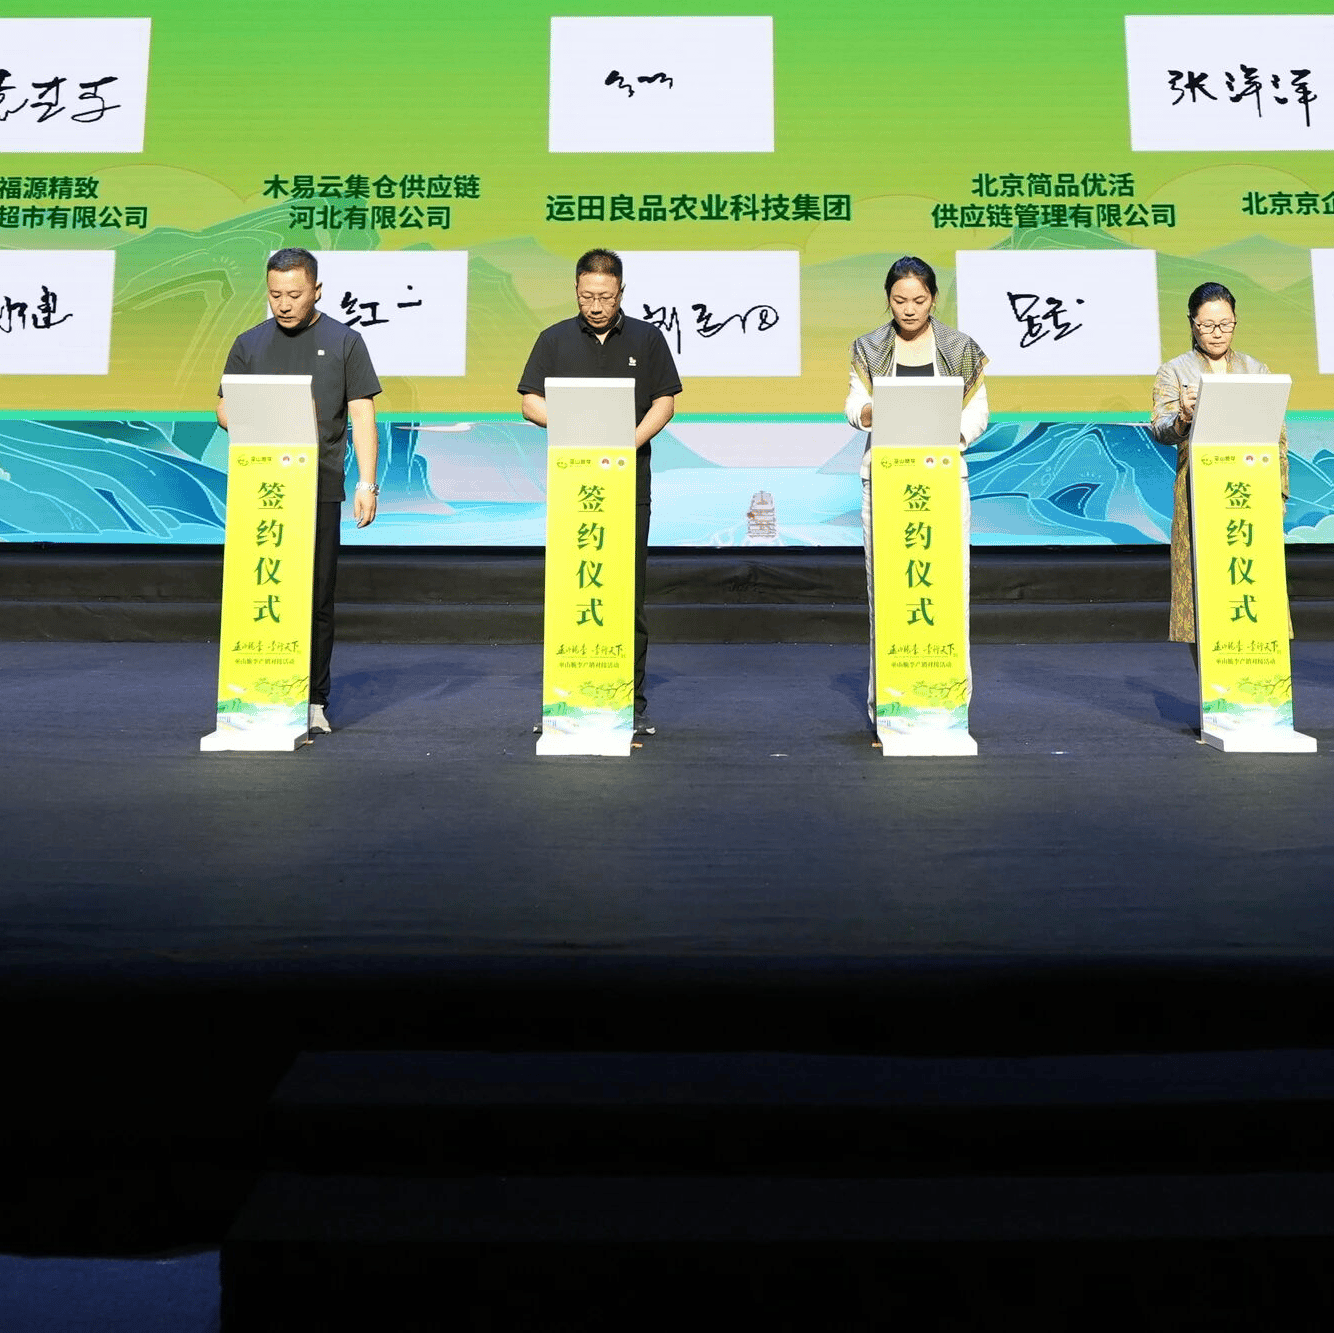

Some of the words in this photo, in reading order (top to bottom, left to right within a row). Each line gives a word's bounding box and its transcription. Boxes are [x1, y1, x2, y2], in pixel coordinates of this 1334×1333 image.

[263, 174, 480, 199] 木易云集仓供应链
[972, 172, 1134, 197] 北京简品优活
[289, 205, 450, 230] 河北有限公司
[546, 193, 851, 222] 运田良品农业科技集团
[931, 203, 1175, 229] 供应链管理有限公司
[253, 481, 286, 624] 签约仪式
[575, 484, 606, 627] 签约仪式
[903, 483, 935, 627] 签约仪式
[1224, 480, 1257, 624] 签约仪式
